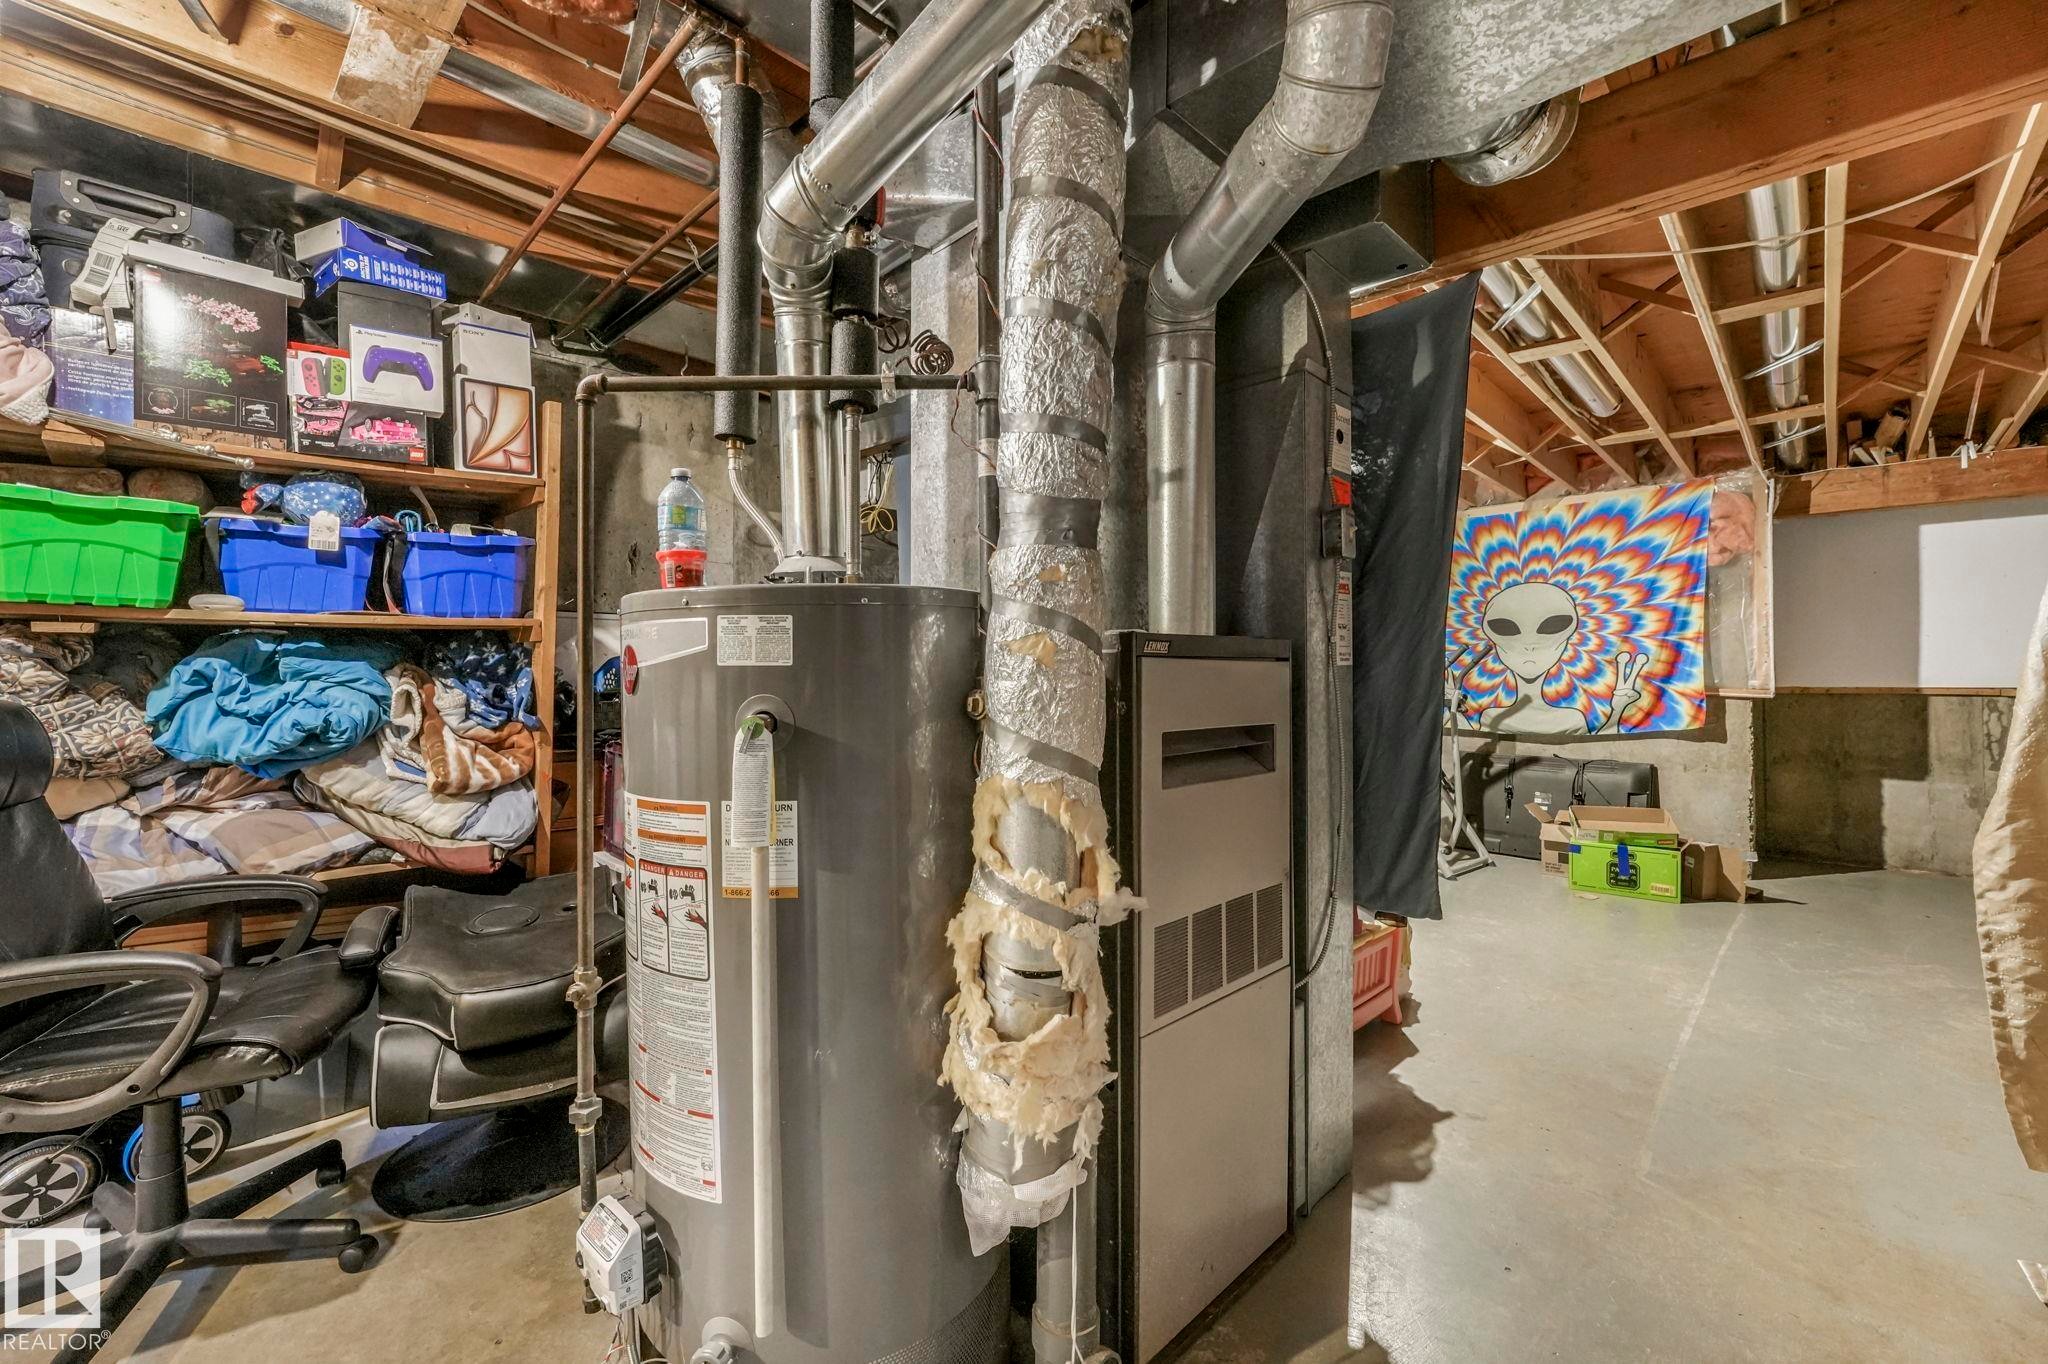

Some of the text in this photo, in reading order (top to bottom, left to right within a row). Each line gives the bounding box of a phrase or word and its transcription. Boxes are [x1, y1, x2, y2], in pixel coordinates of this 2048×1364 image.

[463, 329, 485, 337] SONY
[1144, 641, 1170, 651] LENNOX
[644, 864, 666, 875] DANGER
[675, 870, 705, 878] DANGER
